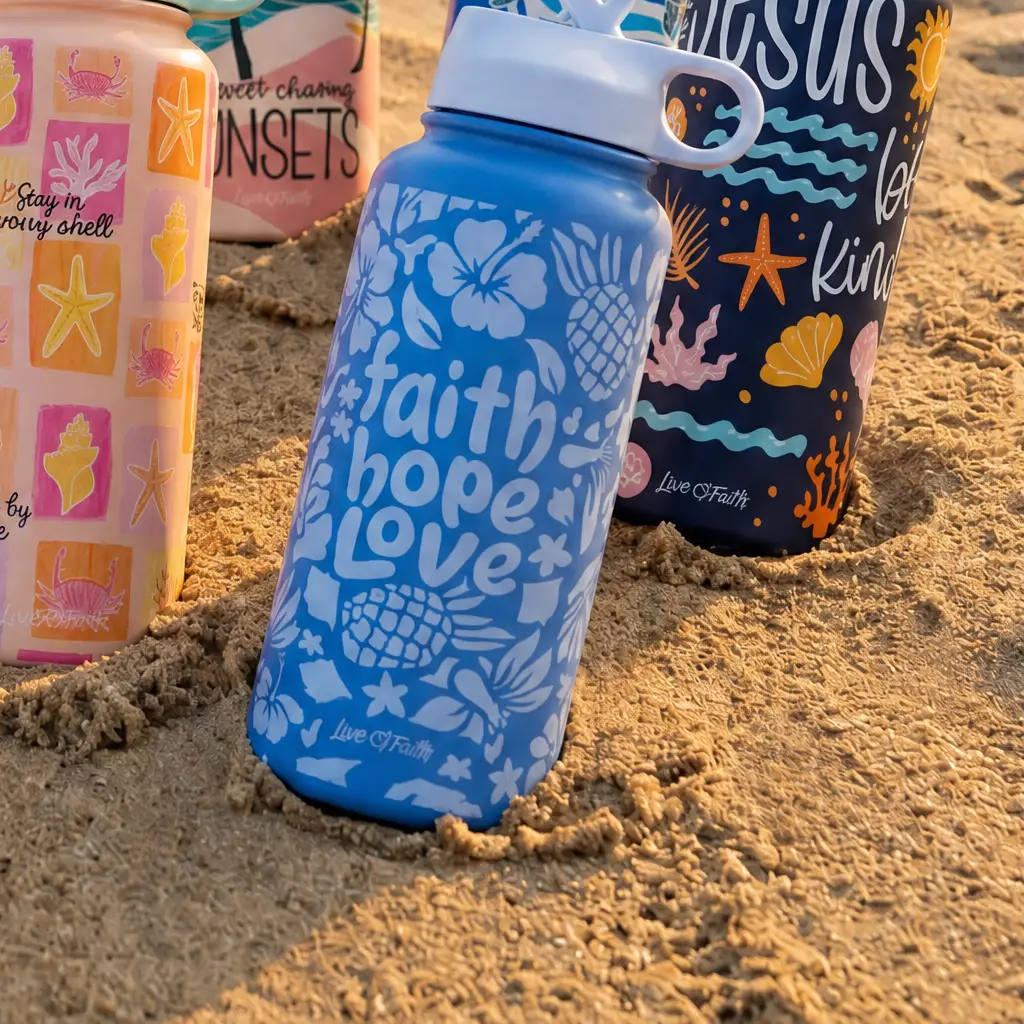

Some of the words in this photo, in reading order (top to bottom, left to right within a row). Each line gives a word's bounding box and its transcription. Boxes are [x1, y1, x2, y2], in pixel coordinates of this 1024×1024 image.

[217, 77, 268, 100] weet
[276, 75, 356, 107] chasing
[213, 107, 360, 181] NSETS
[16, 182, 59, 217] Stay
[64, 192, 85, 211] in
[57, 212, 114, 238] shell
[360, 329, 557, 474] faith
[346, 426, 540, 534] hope
[655, 470, 691, 494] Live
[5, 491, 32, 528] by
[334, 506, 522, 596] Love
[329, 718, 369, 744] Live
